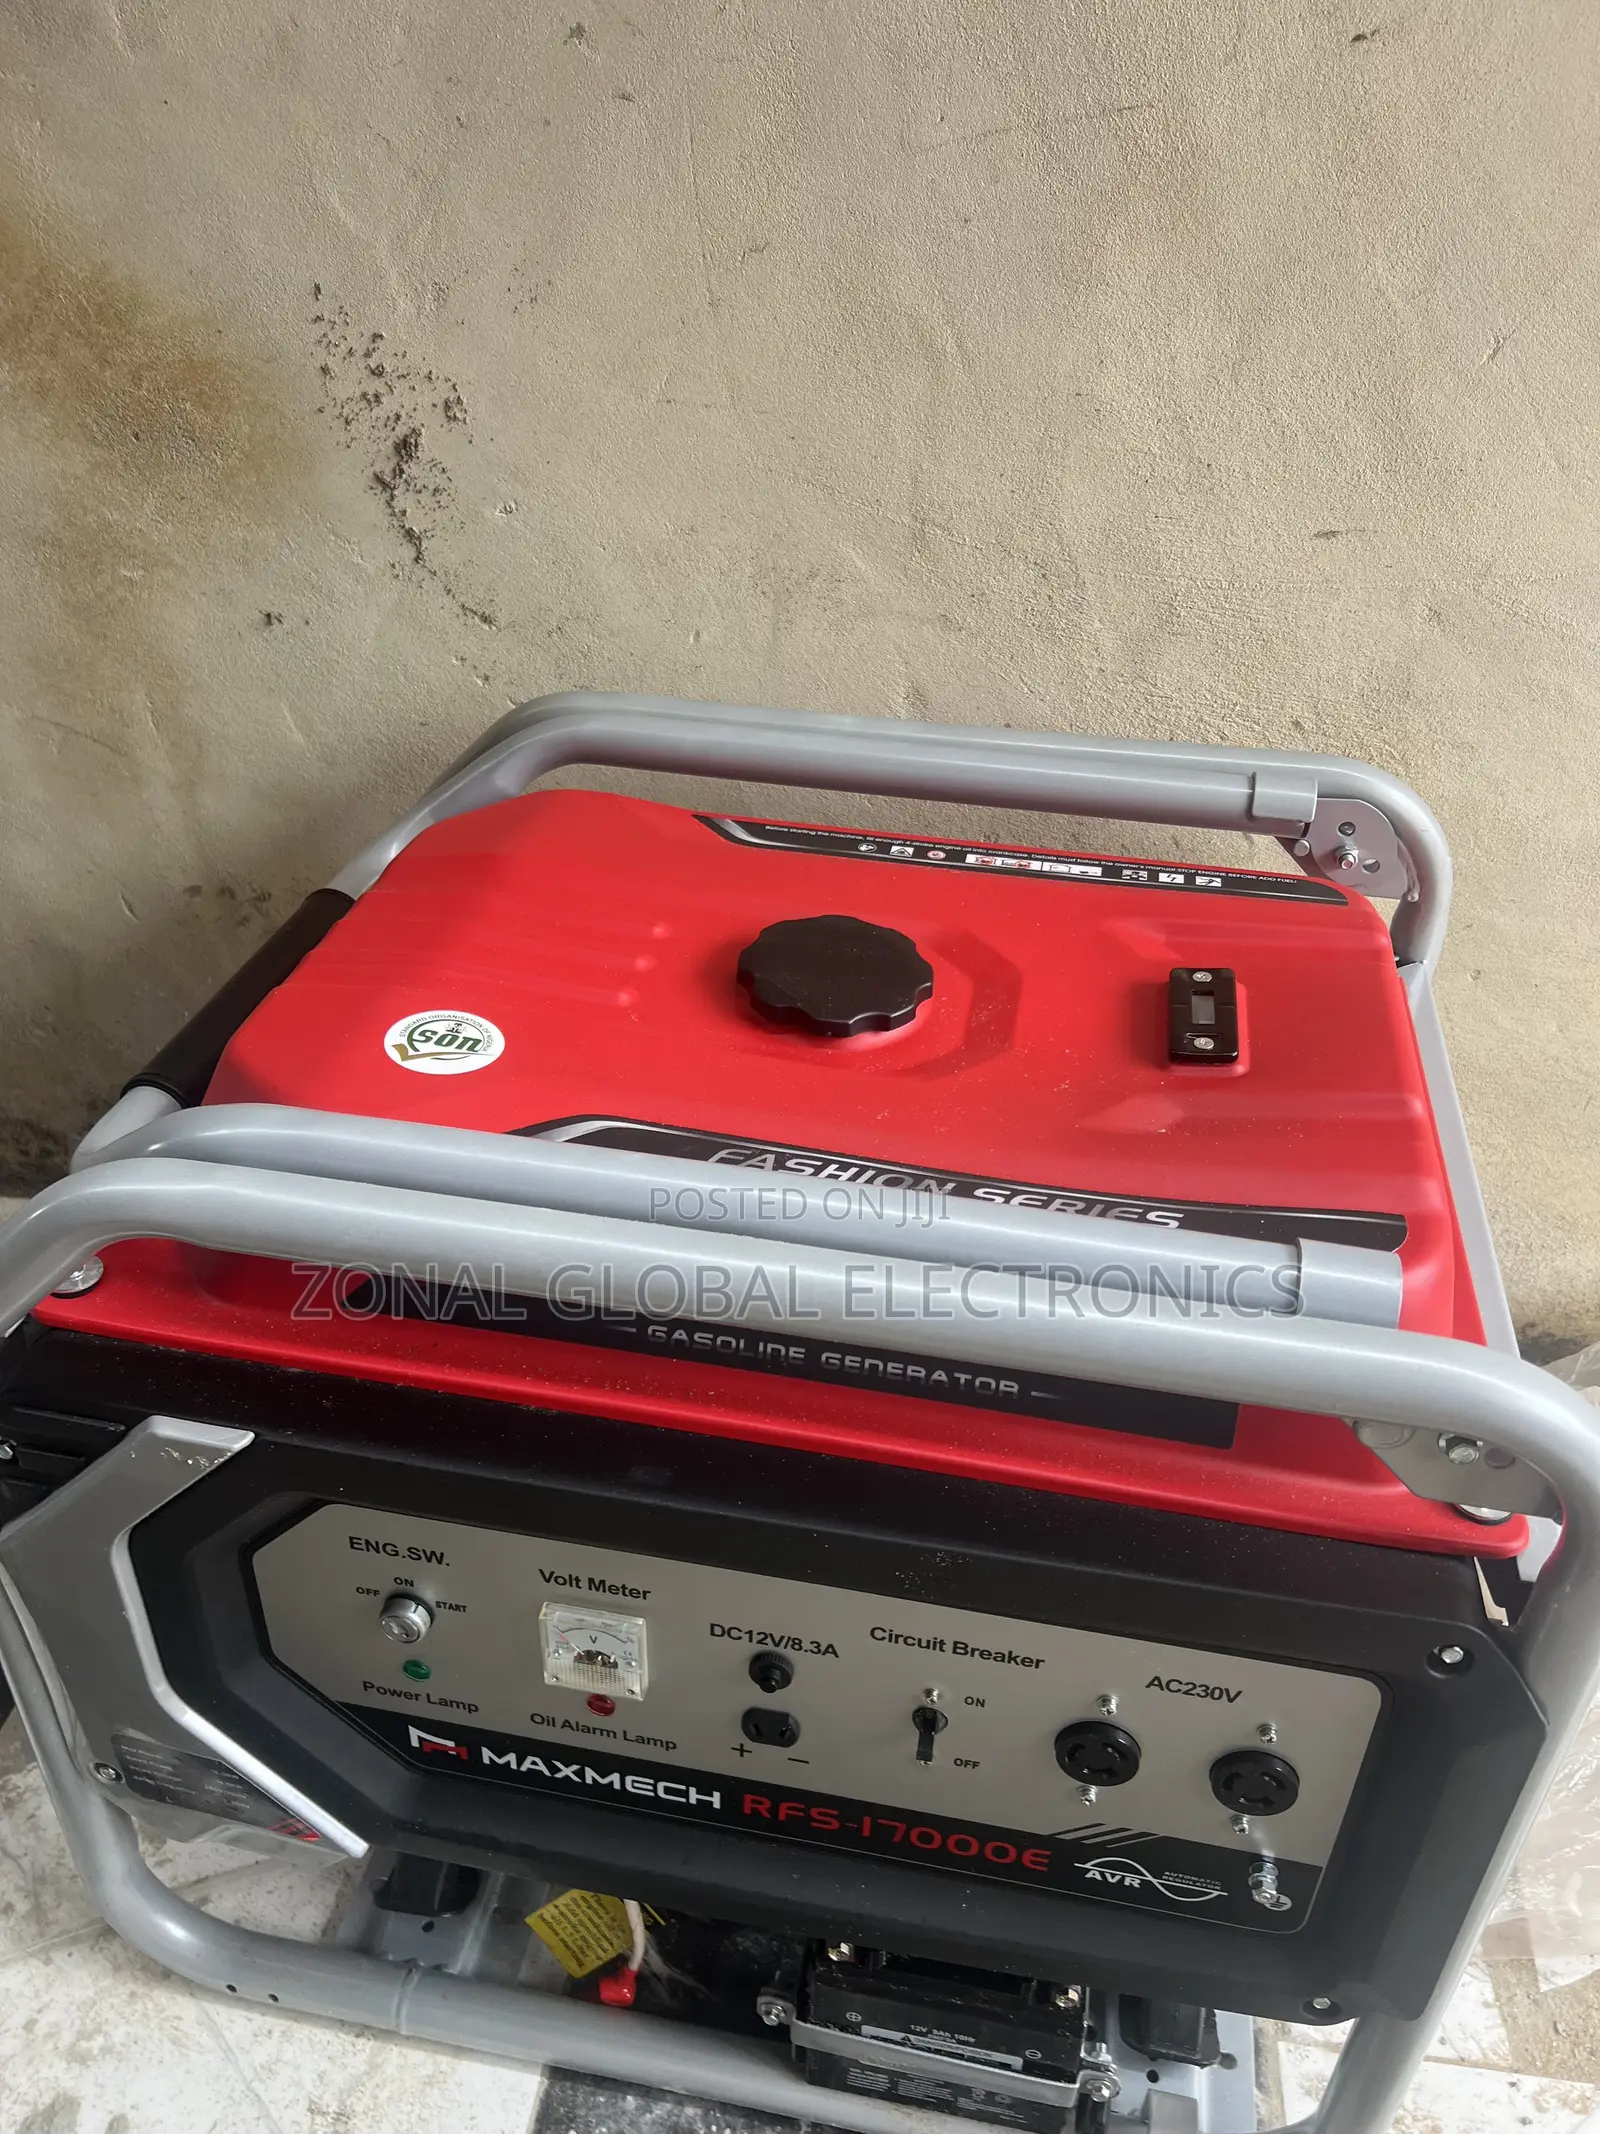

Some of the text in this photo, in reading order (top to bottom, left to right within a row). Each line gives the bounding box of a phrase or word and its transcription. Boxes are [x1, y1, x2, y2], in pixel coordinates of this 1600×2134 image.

[790, 828, 816, 836] starting
[935, 844, 962, 852] engine
[1228, 872, 1257, 880] BEFORE
[973, 1187, 1185, 1230] SERIES
[647, 1324, 1020, 1399] GASOLINE GENERATOR
[348, 1535, 451, 1567] ENG.SW.
[356, 1586, 380, 1597] OFF
[393, 1576, 415, 1588] ON
[538, 1568, 652, 1601] Volt Meter
[435, 1600, 468, 1613] START
[709, 1622, 840, 1659] DC12V/8.3A
[869, 1626, 1046, 1670] Circuit Breaker
[362, 1680, 479, 1714] Power Lamp
[964, 1696, 986, 1708] ON
[1145, 1675, 1243, 1704] AC230V
[530, 1712, 678, 1752] Oil Alarm Lamp
[480, 1746, 722, 1810] MAXMECH
[953, 1757, 981, 1770] OFF
[742, 1793, 1052, 1872] RFS-17000E
[1084, 1869, 1143, 1889] AVR
[1161, 1876, 1222, 1891] REGULATOR
[1163, 1871, 1222, 1886] AUTOMATIC
[909, 2024, 928, 2034] 12V
